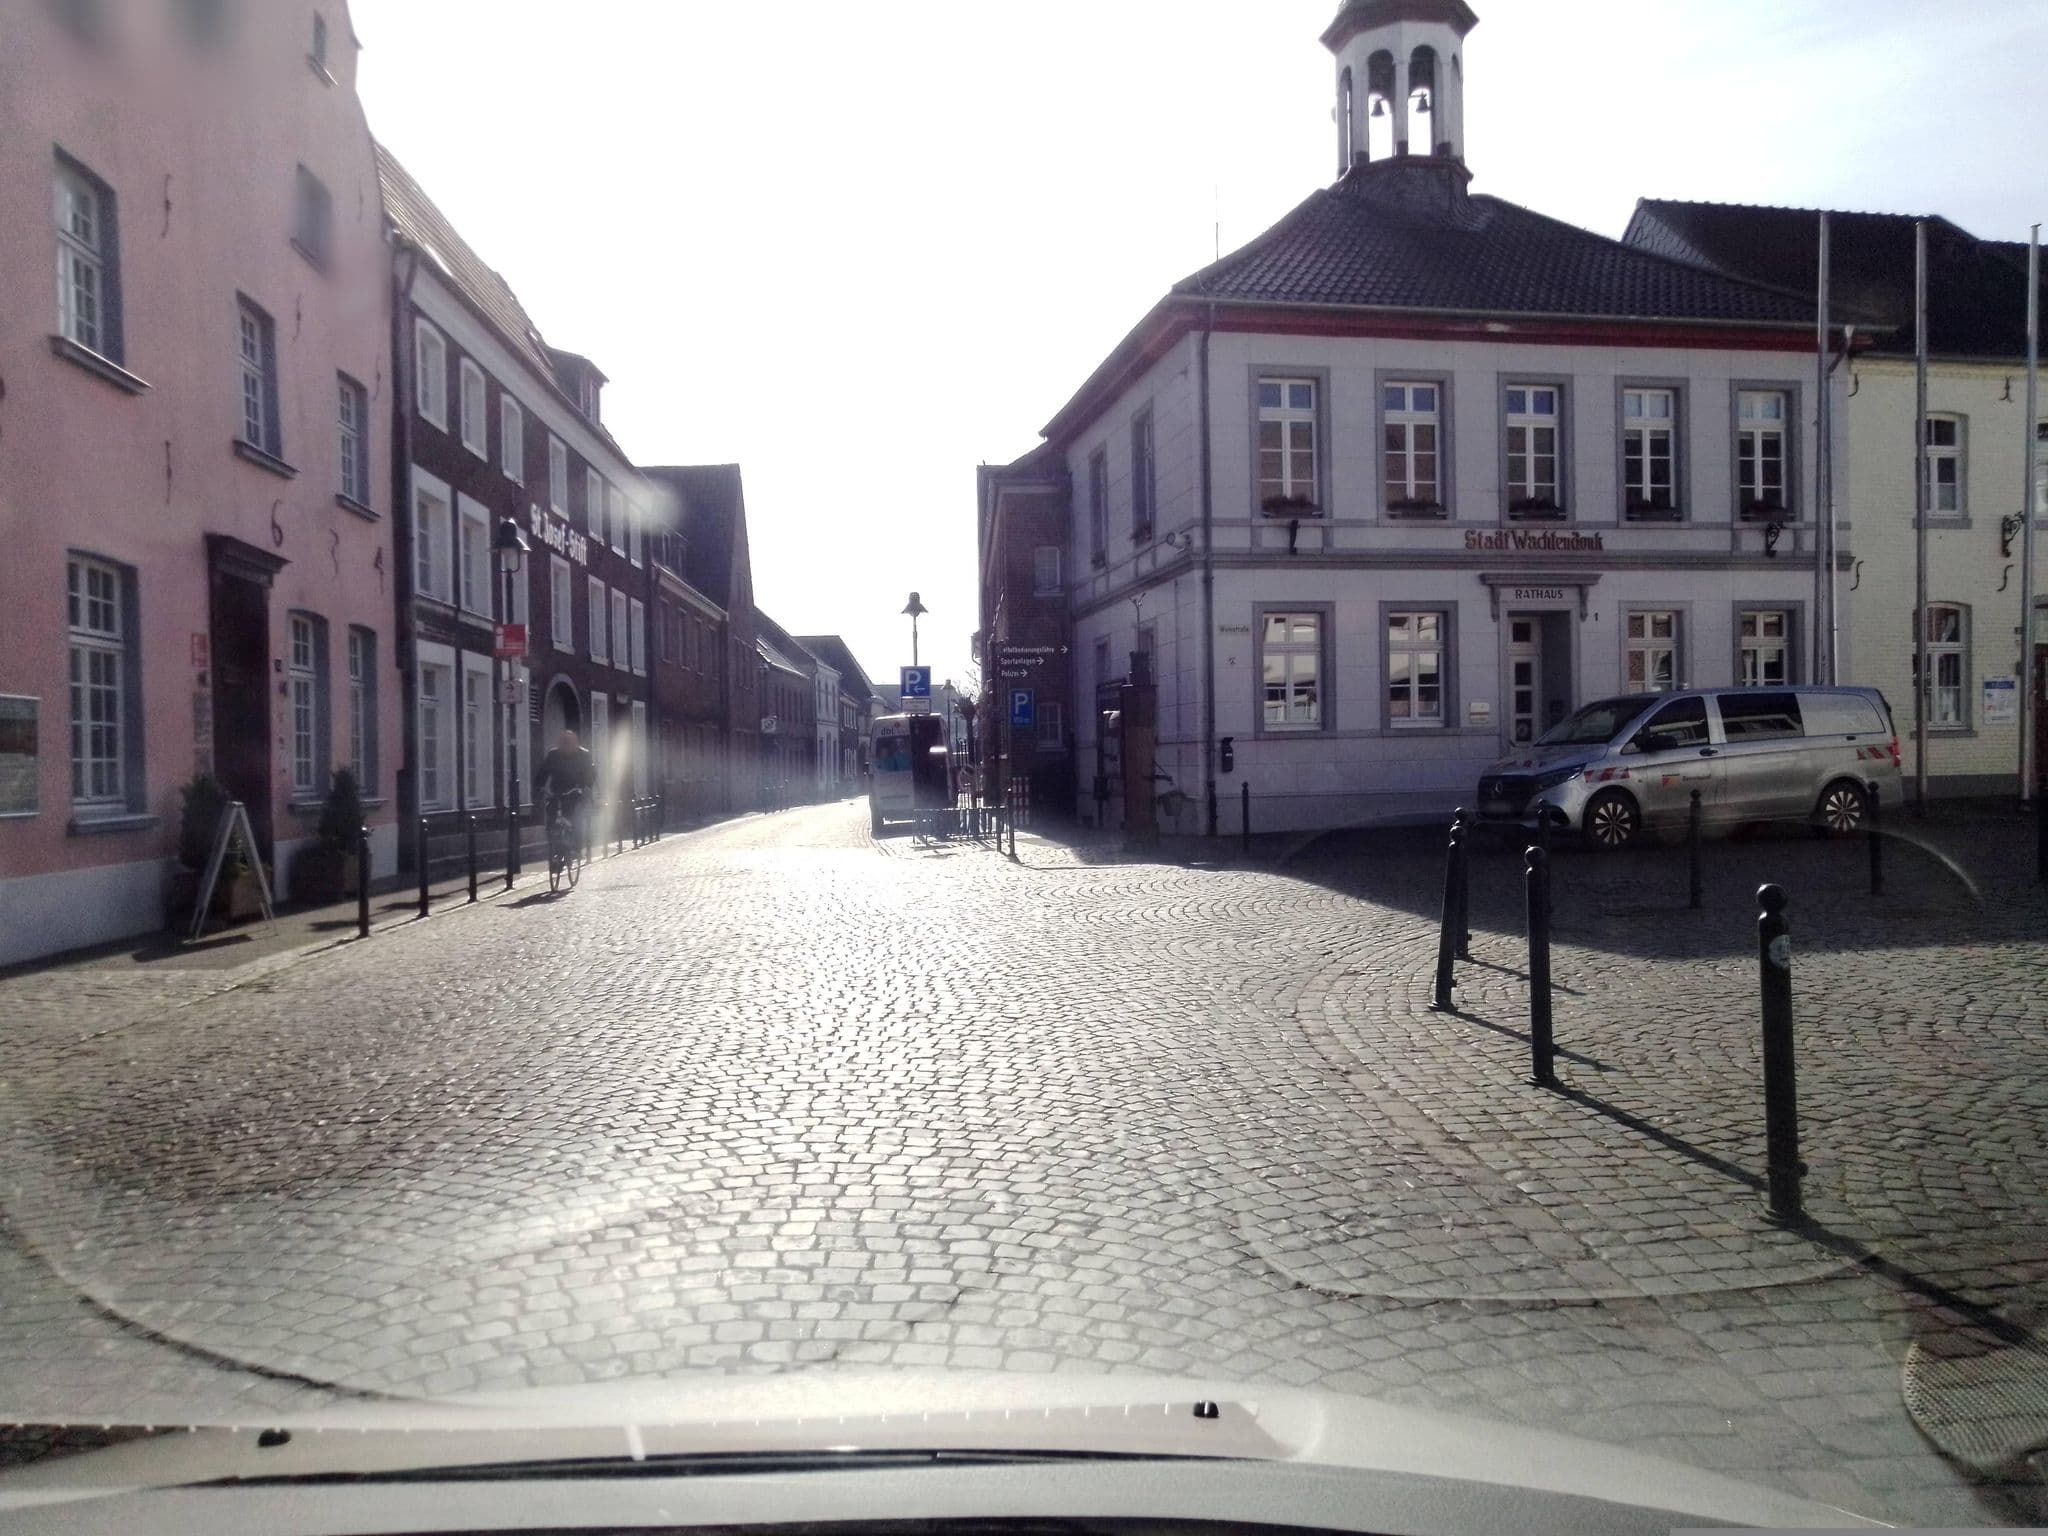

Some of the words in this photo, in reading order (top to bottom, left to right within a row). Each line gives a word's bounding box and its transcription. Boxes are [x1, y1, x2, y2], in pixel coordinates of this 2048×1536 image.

[1465, 529, 1509, 550] Stadt
[1510, 529, 1604, 551] Wachtendonk
[1515, 589, 1564, 600] RATHAUS
[1000, 657, 1036, 666] Sportanlagen
[905, 669, 922, 694] P
[1015, 693, 1029, 715] P
